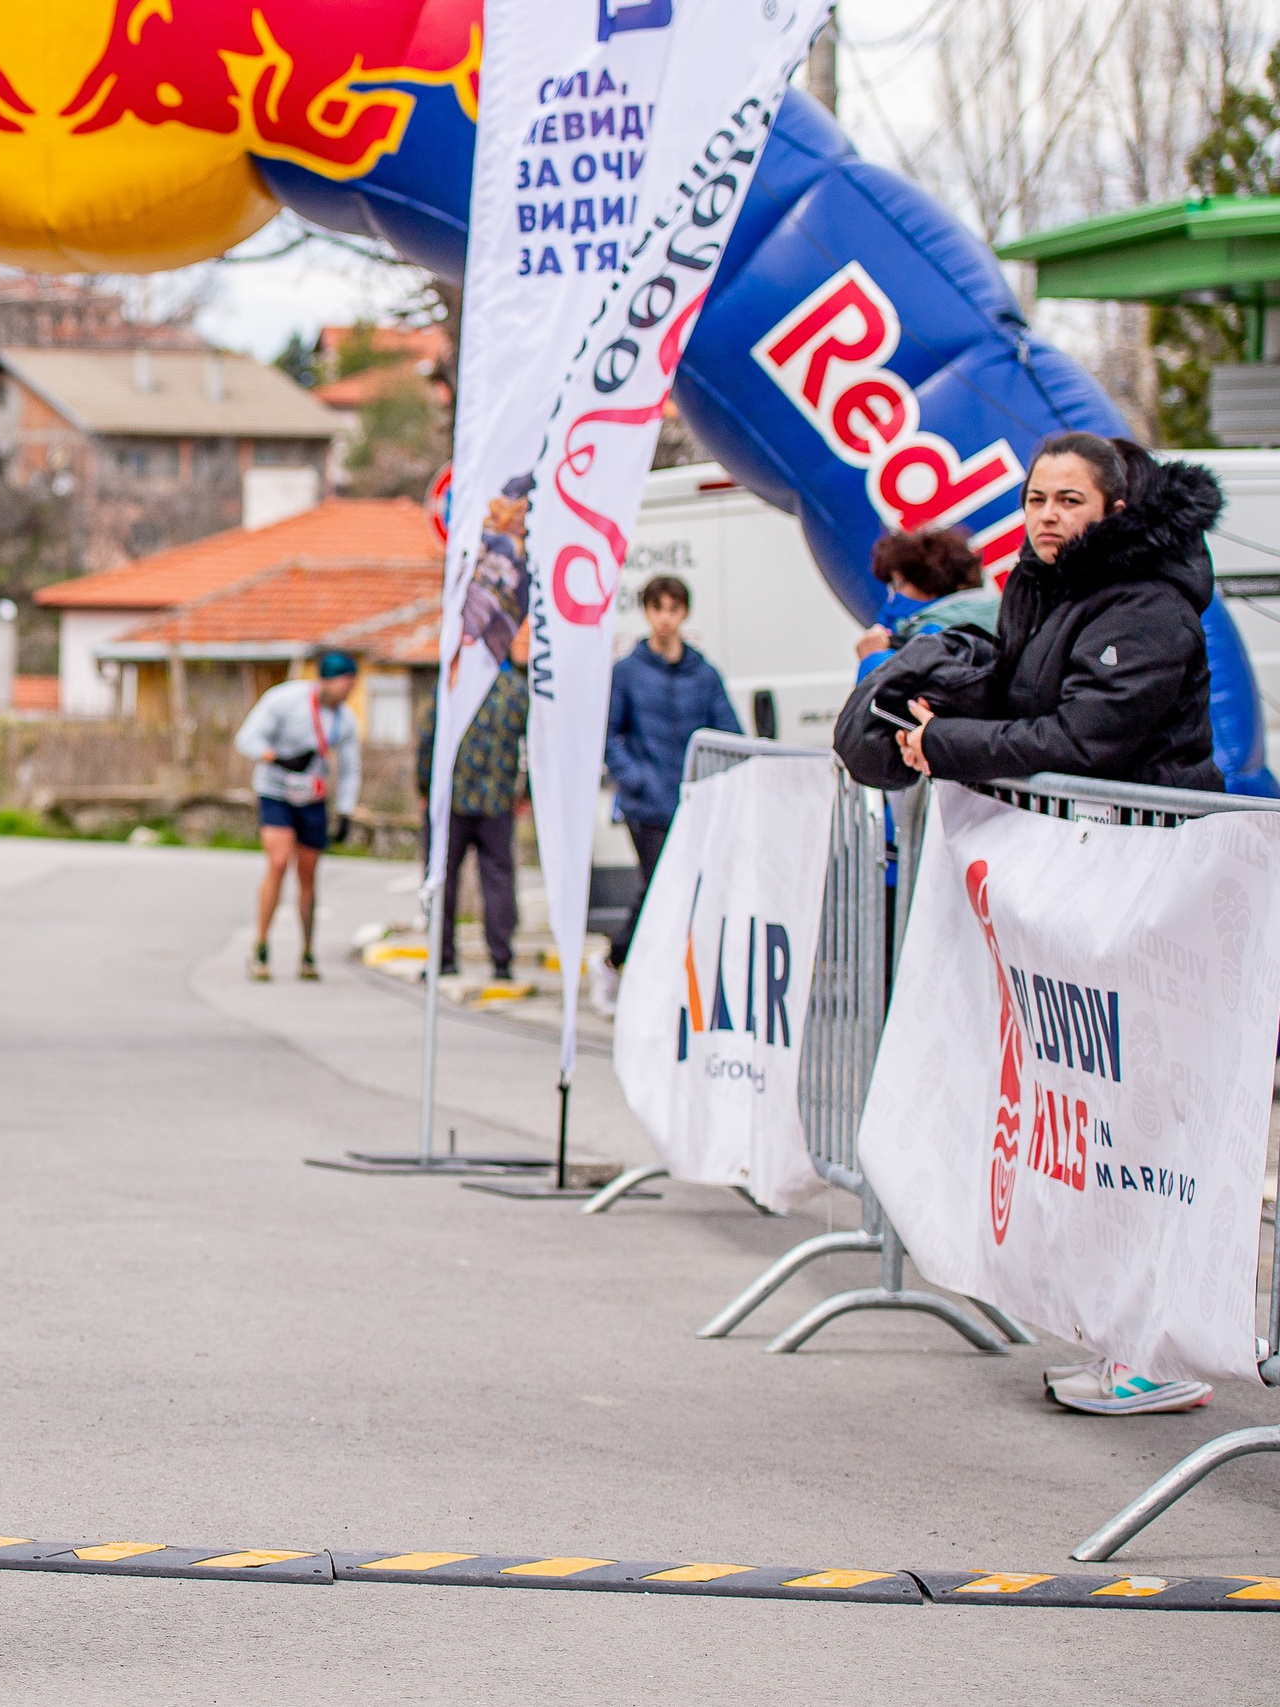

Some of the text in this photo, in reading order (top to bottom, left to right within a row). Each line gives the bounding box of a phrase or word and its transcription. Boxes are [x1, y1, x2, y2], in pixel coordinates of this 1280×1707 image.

[517, 157, 561, 190] ЗА
[518, 246, 563, 277] ЗА
[760, 270, 1017, 538] Red
[1094, 1118, 1113, 1148] IN
